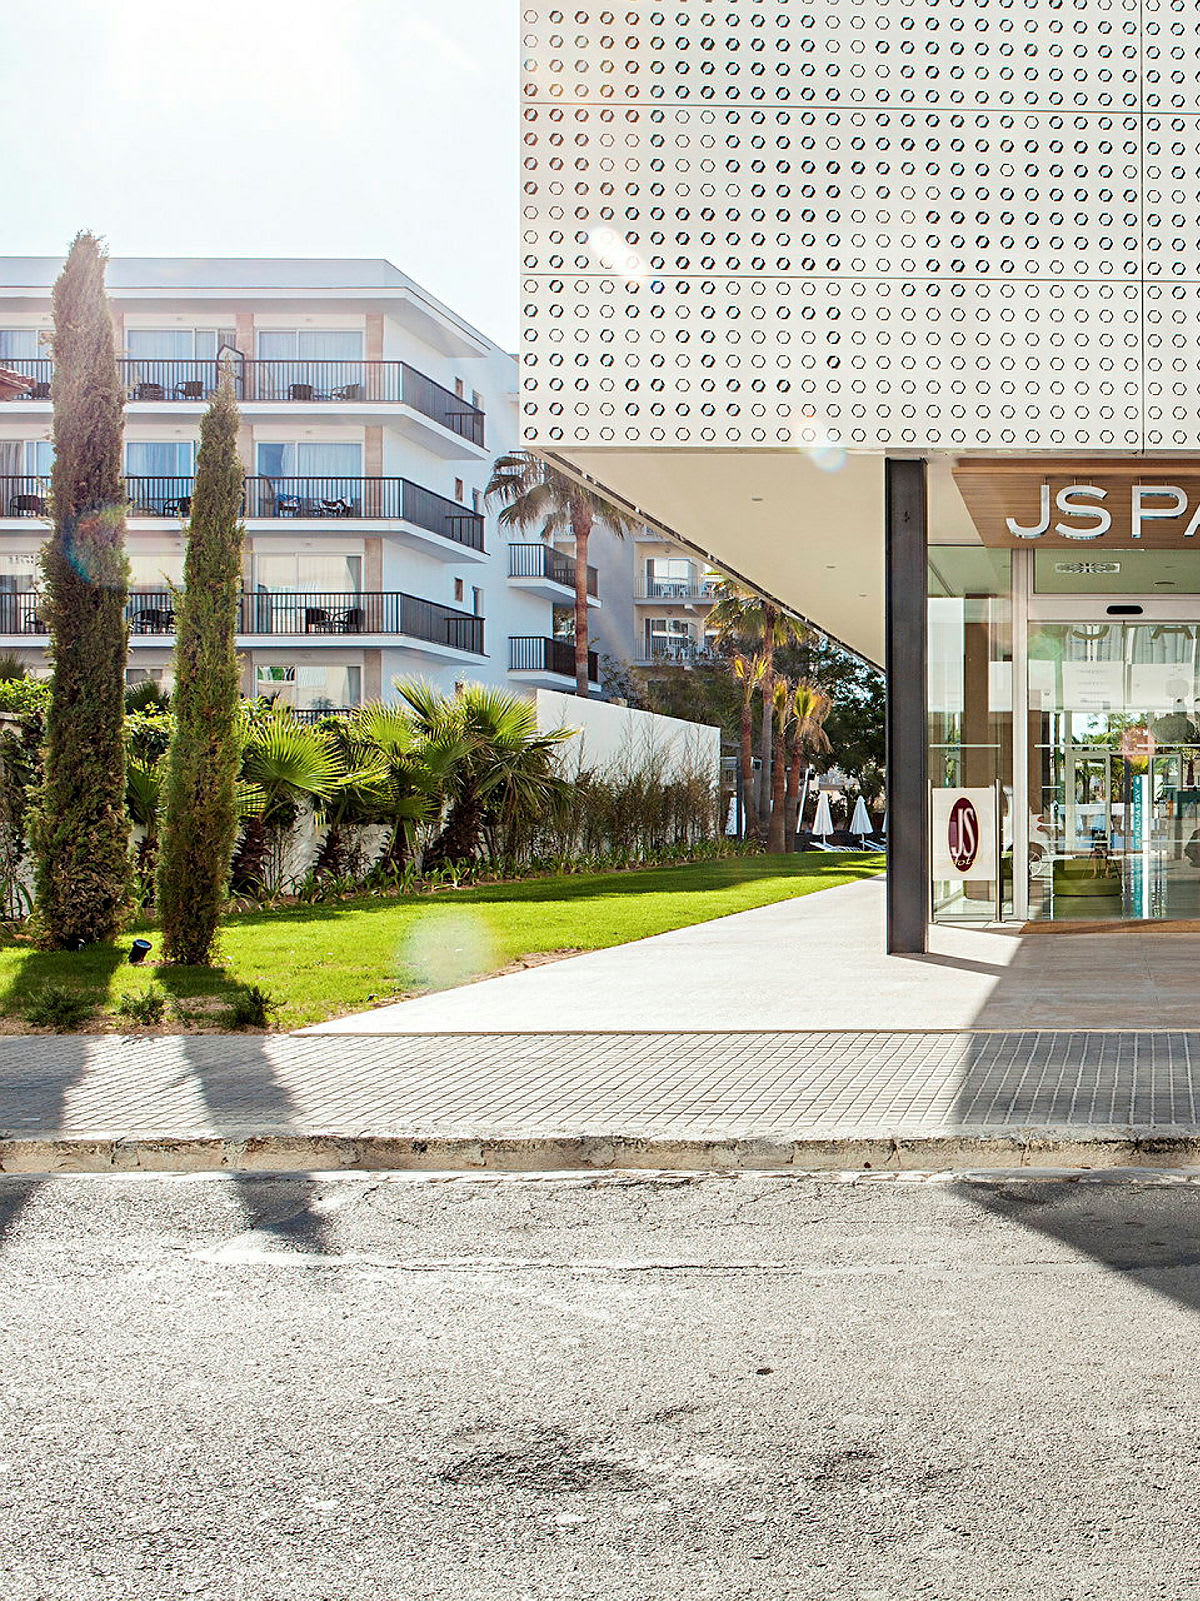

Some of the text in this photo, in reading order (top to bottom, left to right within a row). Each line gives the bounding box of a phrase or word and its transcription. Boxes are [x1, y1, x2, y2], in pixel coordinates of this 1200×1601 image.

[1005, 484, 1112, 540] JS
[1134, 788, 1142, 809] STAY
[950, 807, 976, 858] JS
[1134, 810, 1142, 836] PALMA
